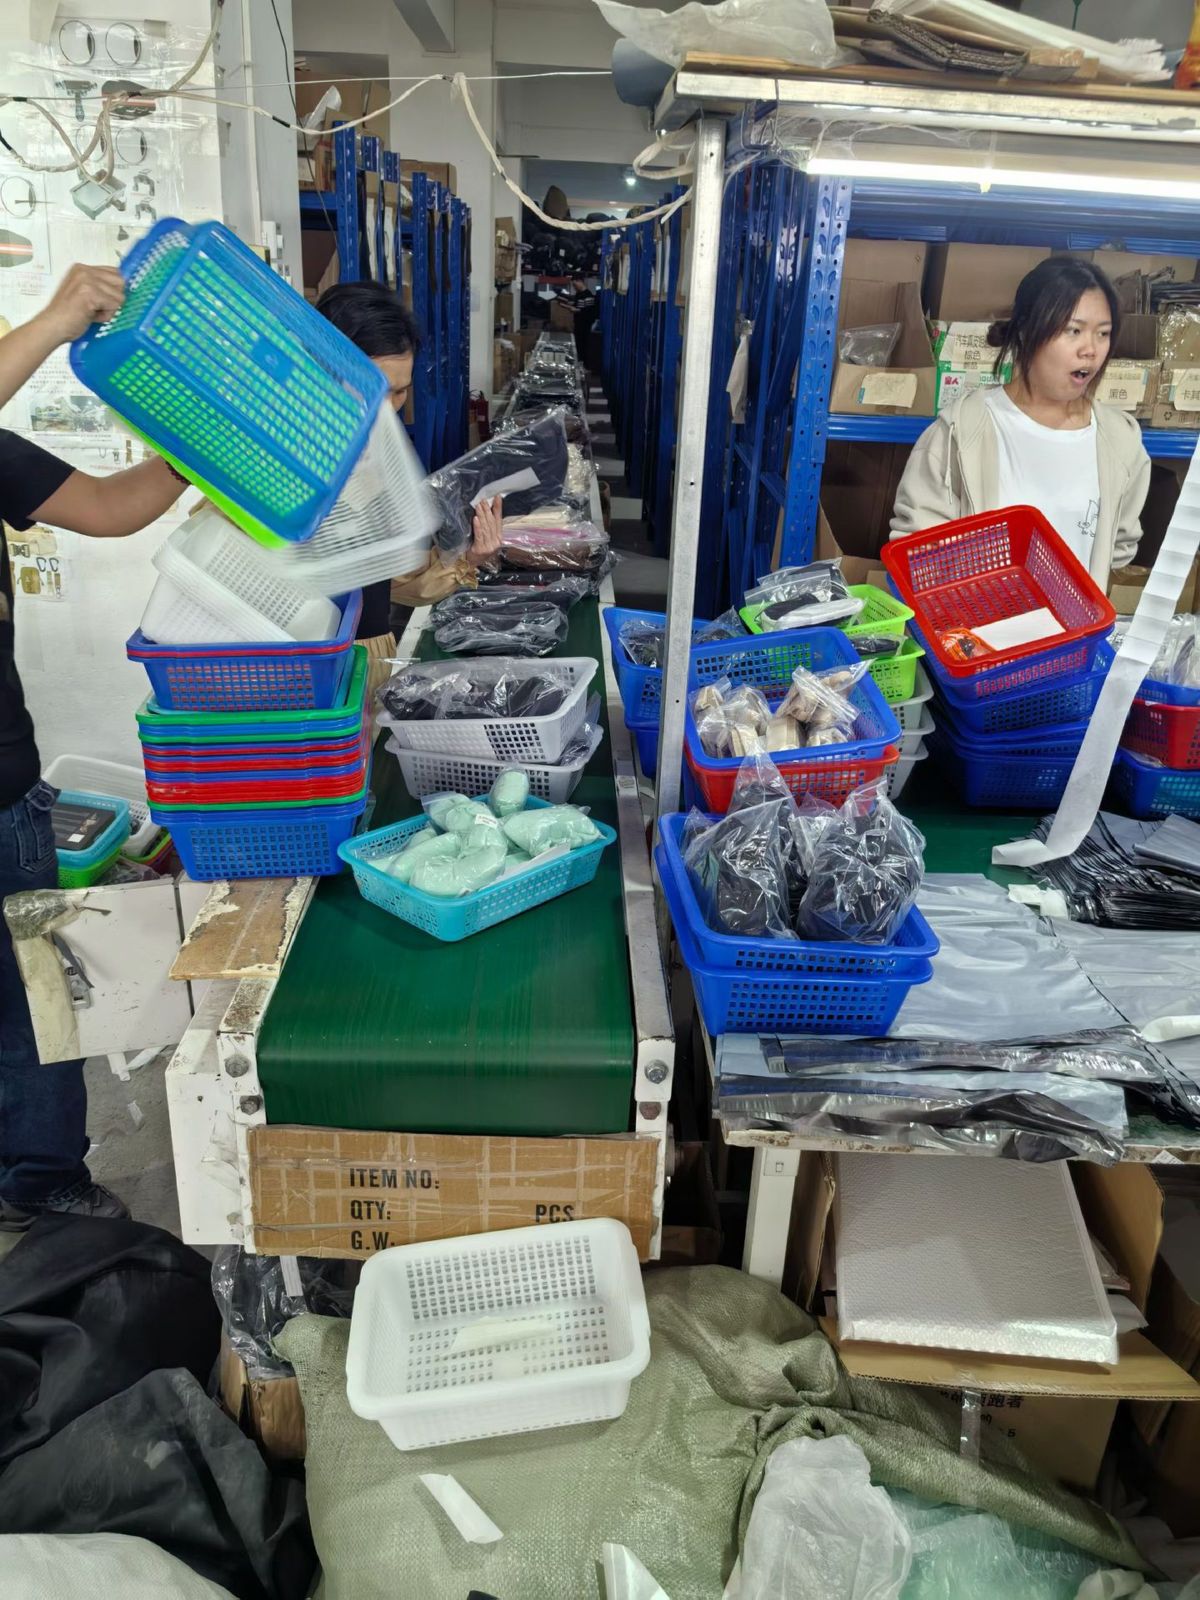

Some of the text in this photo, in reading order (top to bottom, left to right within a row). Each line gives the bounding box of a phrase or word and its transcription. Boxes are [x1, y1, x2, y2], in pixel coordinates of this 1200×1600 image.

[1109, 388, 1128, 400] 黑色
[349, 1167, 440, 1190] ITEM NO:
[350, 1199, 391, 1221] QTY:
[535, 1203, 575, 1223] PCS
